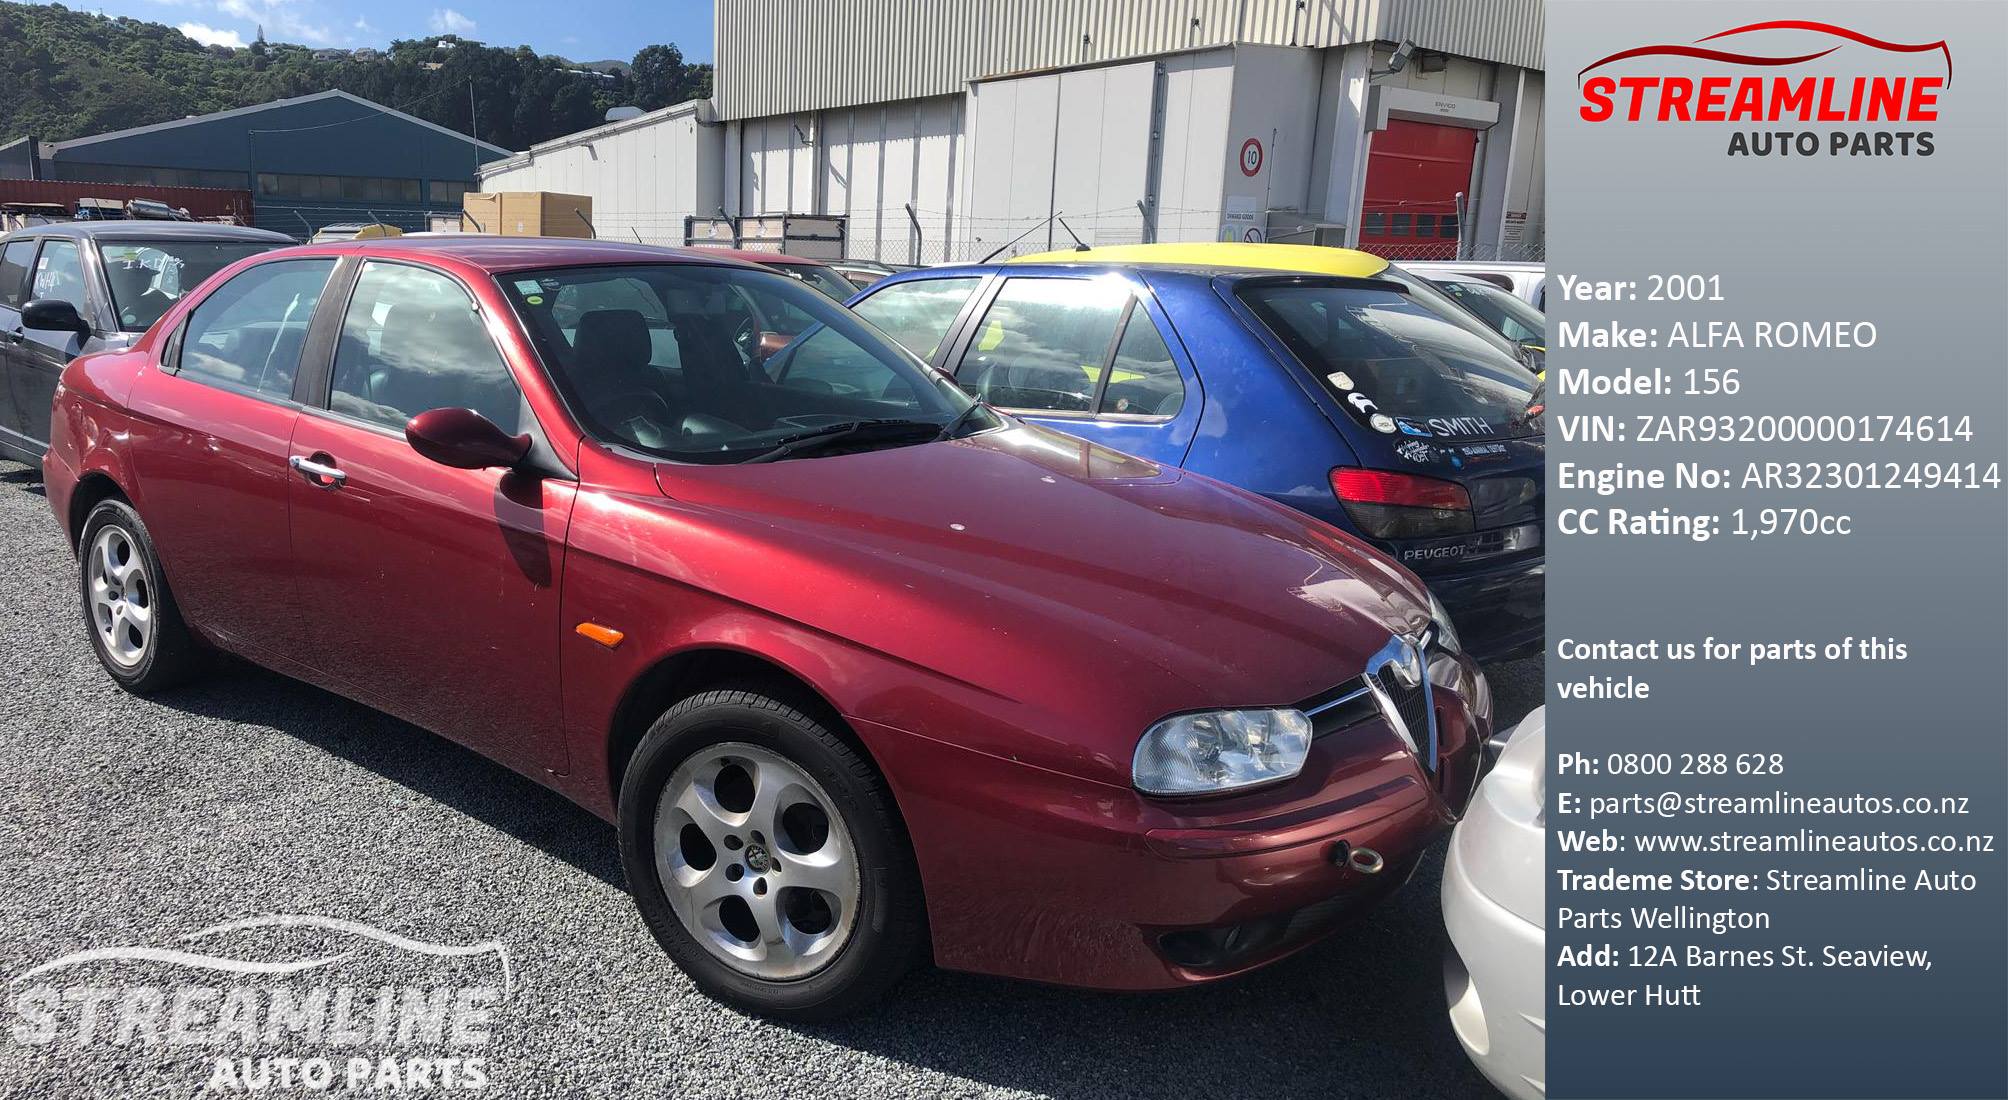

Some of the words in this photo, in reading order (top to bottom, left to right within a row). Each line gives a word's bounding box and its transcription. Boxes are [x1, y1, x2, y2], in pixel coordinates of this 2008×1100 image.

[1248, 150, 1257, 165] 10
[1428, 416, 1495, 437] SMITH
[1404, 544, 1466, 560] PEUGEOT
